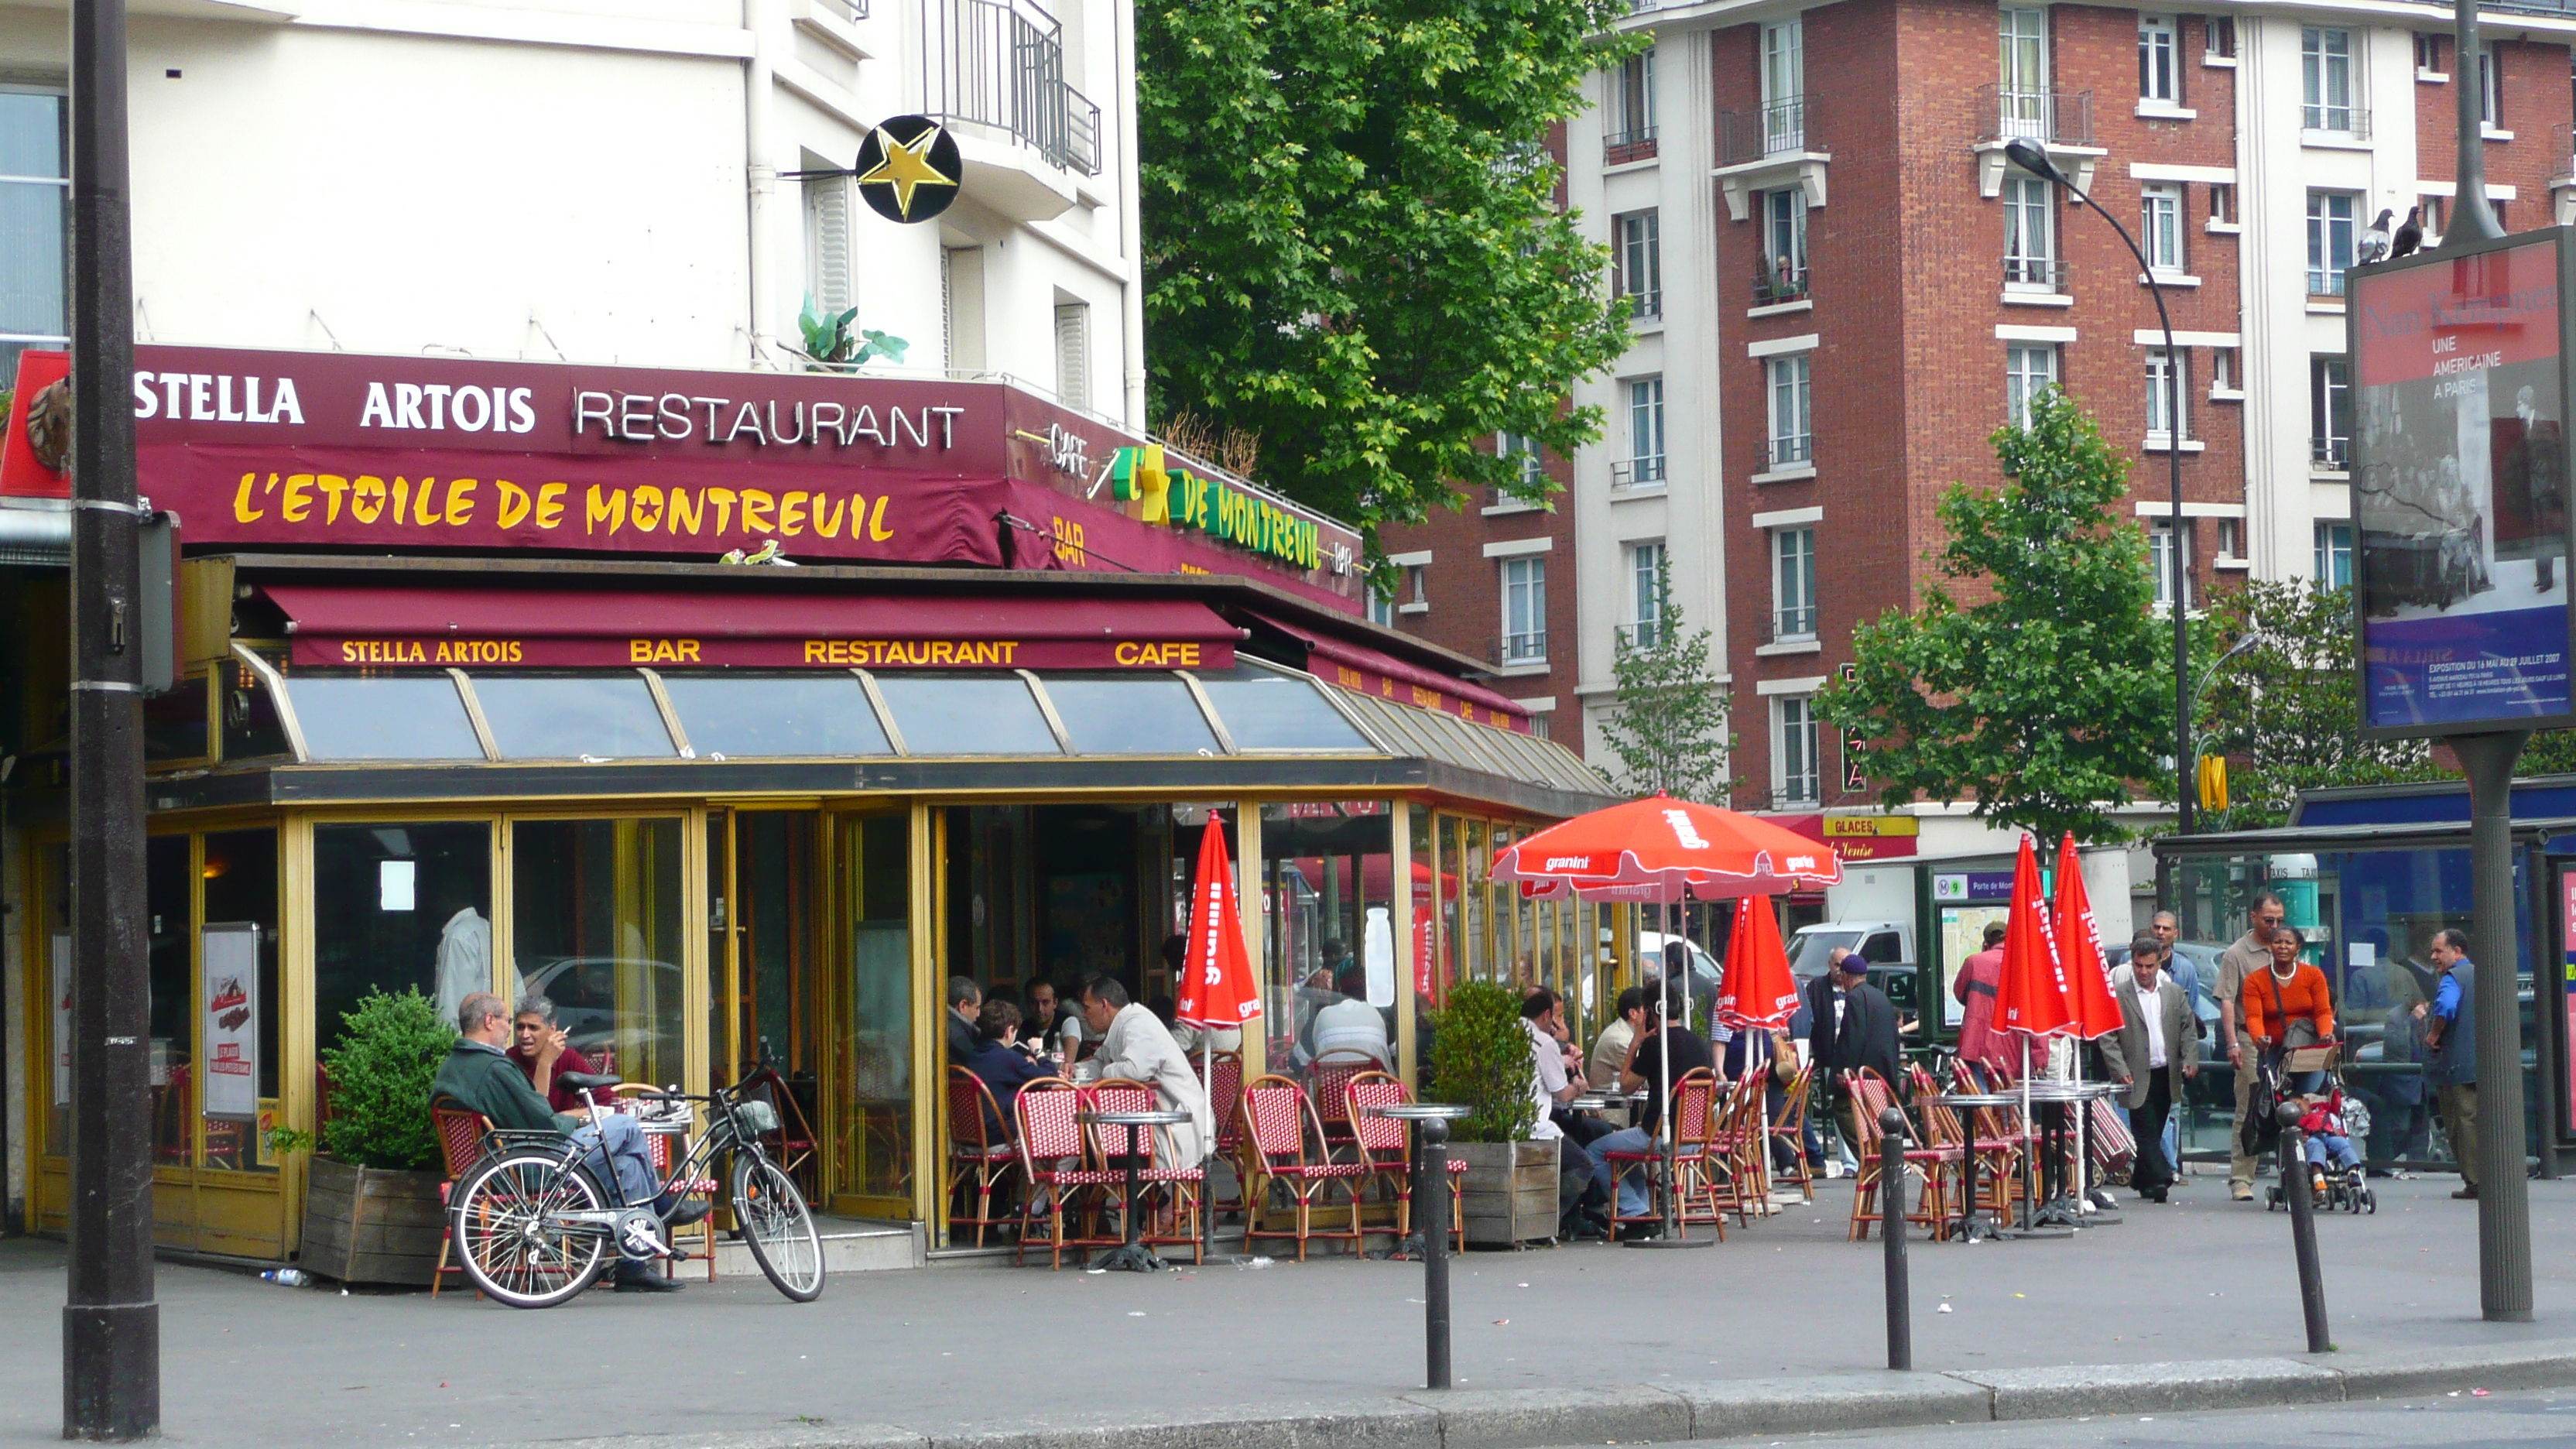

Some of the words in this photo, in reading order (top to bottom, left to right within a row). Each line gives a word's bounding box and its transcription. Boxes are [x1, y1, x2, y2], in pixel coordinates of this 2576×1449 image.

[2365, 301, 2421, 340] Nan
[2432, 336, 2456, 355] UNE
[2433, 351, 2501, 377] AMERICAINE
[134, 371, 305, 424] STELLA
[360, 382, 535, 433] ARTOIS
[2434, 384, 2442, 399] A
[2444, 379, 2476, 396] PARIS
[576, 391, 964, 449] RESTAURANT
[234, 472, 478, 526] L'ETOILE
[496, 480, 568, 530] DE
[586, 481, 894, 541] MONTREUIL
[1167, 468, 1208, 529] DE
[1206, 481, 1321, 570] MONTREUIL
[1053, 516, 1086, 567] BAR
[342, 640, 426, 663] STELLA
[435, 640, 522, 663] ARTOIS
[630, 639, 701, 663] BAR
[804, 640, 1019, 664] RESTAURANT
[1115, 642, 1201, 666] CAFE
[2429, 661, 2465, 673] EXPOSITION
[2466, 660, 2475, 670] DU
[2486, 658, 2497, 668] MAI
[2518, 654, 2543, 665] JUILLET
[2199, 755, 2228, 810] M
[1835, 820, 1873, 833] GLACES
[1842, 841, 1874, 857] Venise
[1545, 856, 1588, 872] granini
[1952, 880, 1958, 892] 9
[1973, 882, 1989, 890] Porte
[1990, 882, 1998, 890] de
